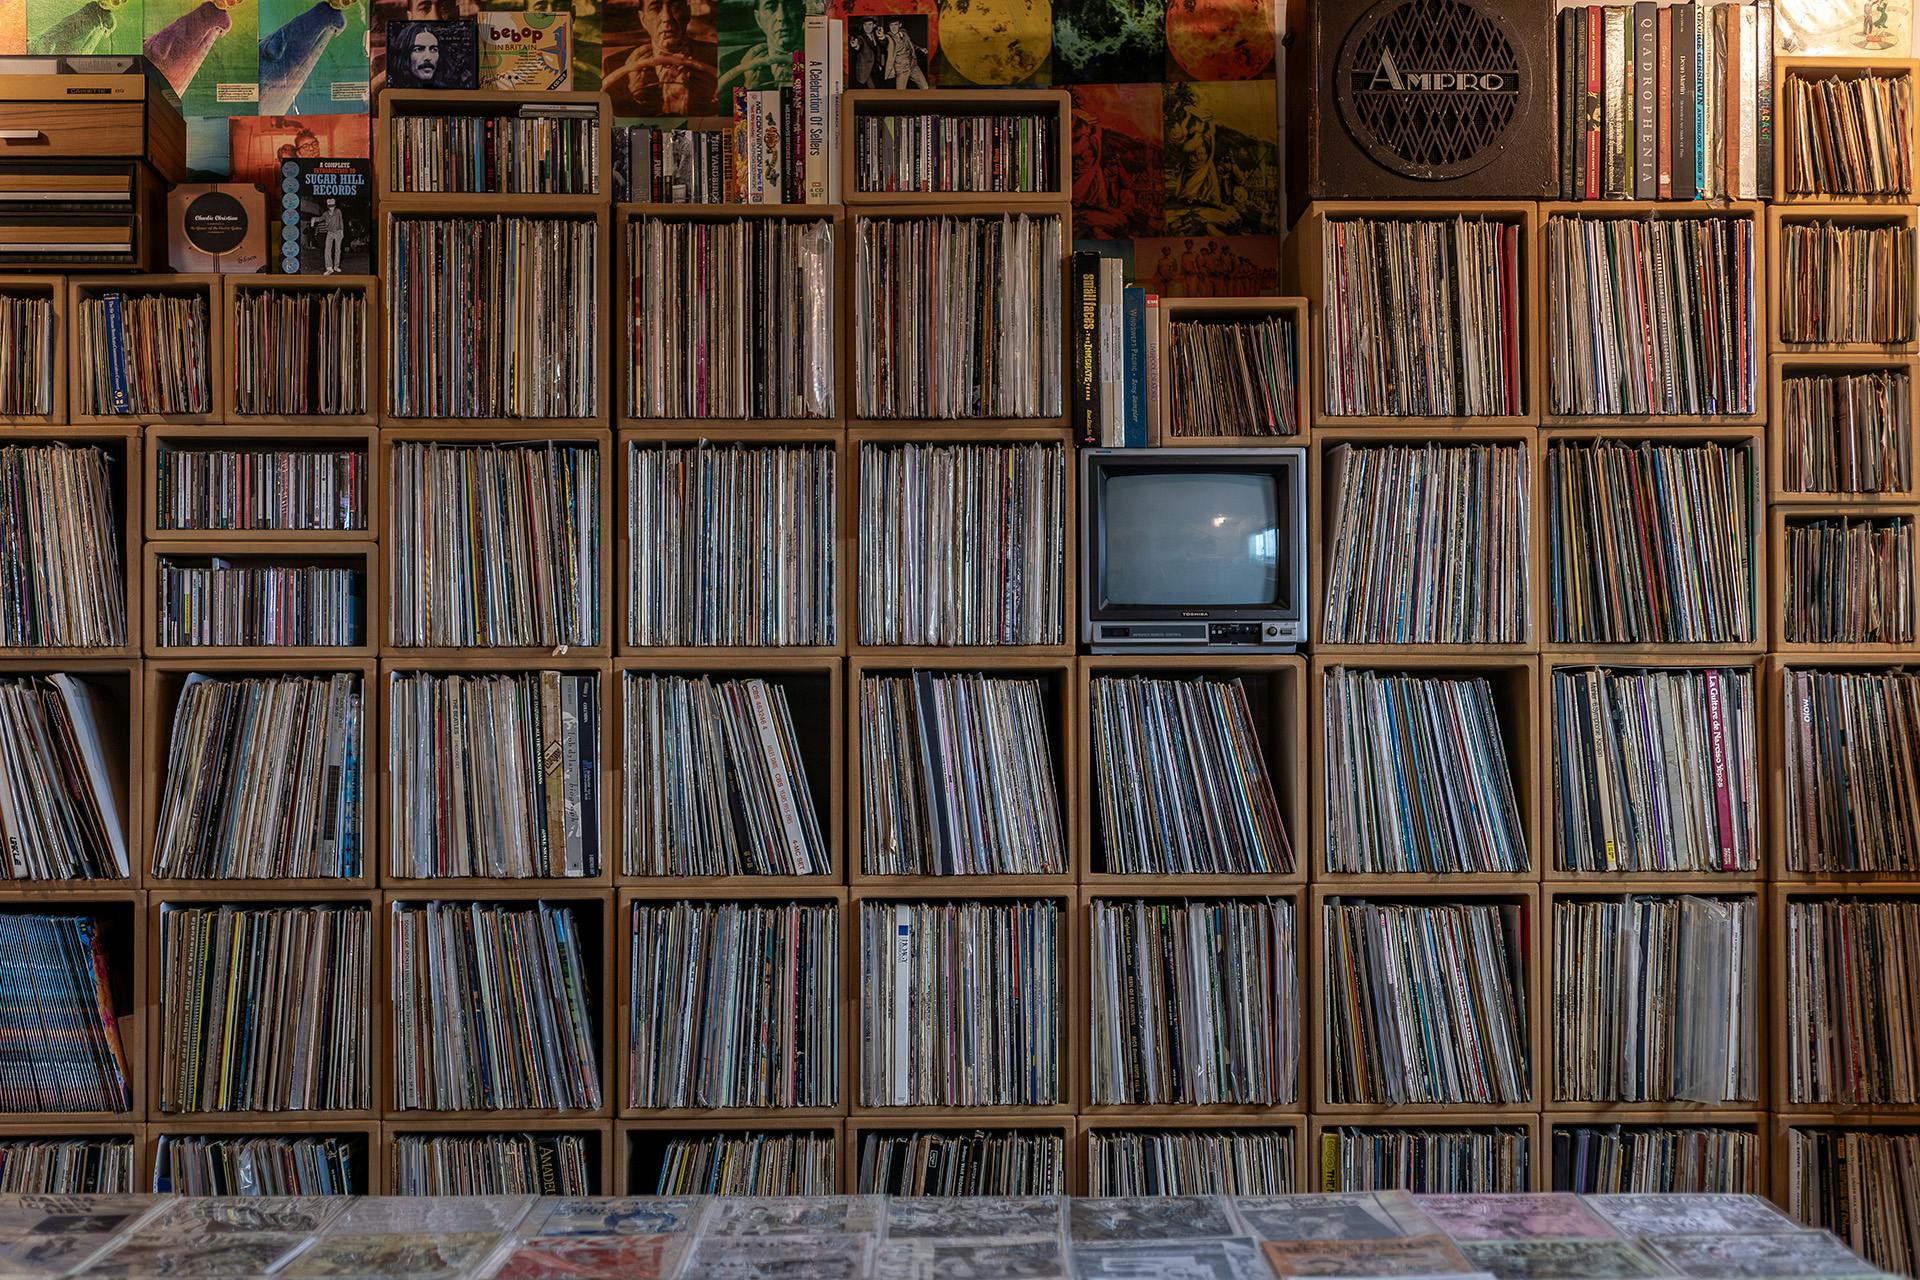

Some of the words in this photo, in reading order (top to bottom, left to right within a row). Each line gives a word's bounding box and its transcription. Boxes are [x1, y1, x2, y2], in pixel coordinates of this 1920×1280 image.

[490, 27, 543, 44] bebop
[809, 69, 823, 114] Celebration
[1696, 52, 1704, 105] GERSHWIN
[794, 78, 802, 108] CREAM
[1641, 18, 1653, 183] QUADROPHENIA
[756, 101, 762, 114] MC
[809, 116, 823, 126] Of
[711, 134, 720, 153] THE
[809, 128, 823, 156] Sellers
[304, 174, 337, 185] SUGAR
[339, 174, 365, 184] HILL
[312, 184, 357, 196] RECORDS
[711, 154, 720, 203] YARDBIRDS
[1083, 302, 1096, 330] faces
[1083, 343, 1093, 382] IMMEDIATE
[1130, 348, 1138, 372] PACIFIC
[751, 685, 760, 700] CBS
[1709, 675, 1717, 688] La
[1710, 688, 1720, 720] Guitare
[1802, 697, 1811, 723] MOJO
[1590, 681, 1598, 700] Mahler
[1595, 738, 1604, 758] Karajan
[1713, 720, 1720, 731] de
[568, 748, 577, 773] dylan
[1713, 732, 1723, 763] Narciso
[1715, 763, 1725, 789] Yepes
[568, 782, 577, 823] biograph
[774, 773, 783, 788] CBS
[796, 857, 804, 871] SET
[187, 916, 196, 963] Venezuela
[187, 965, 193, 977] de
[182, 1014, 190, 1042] album
